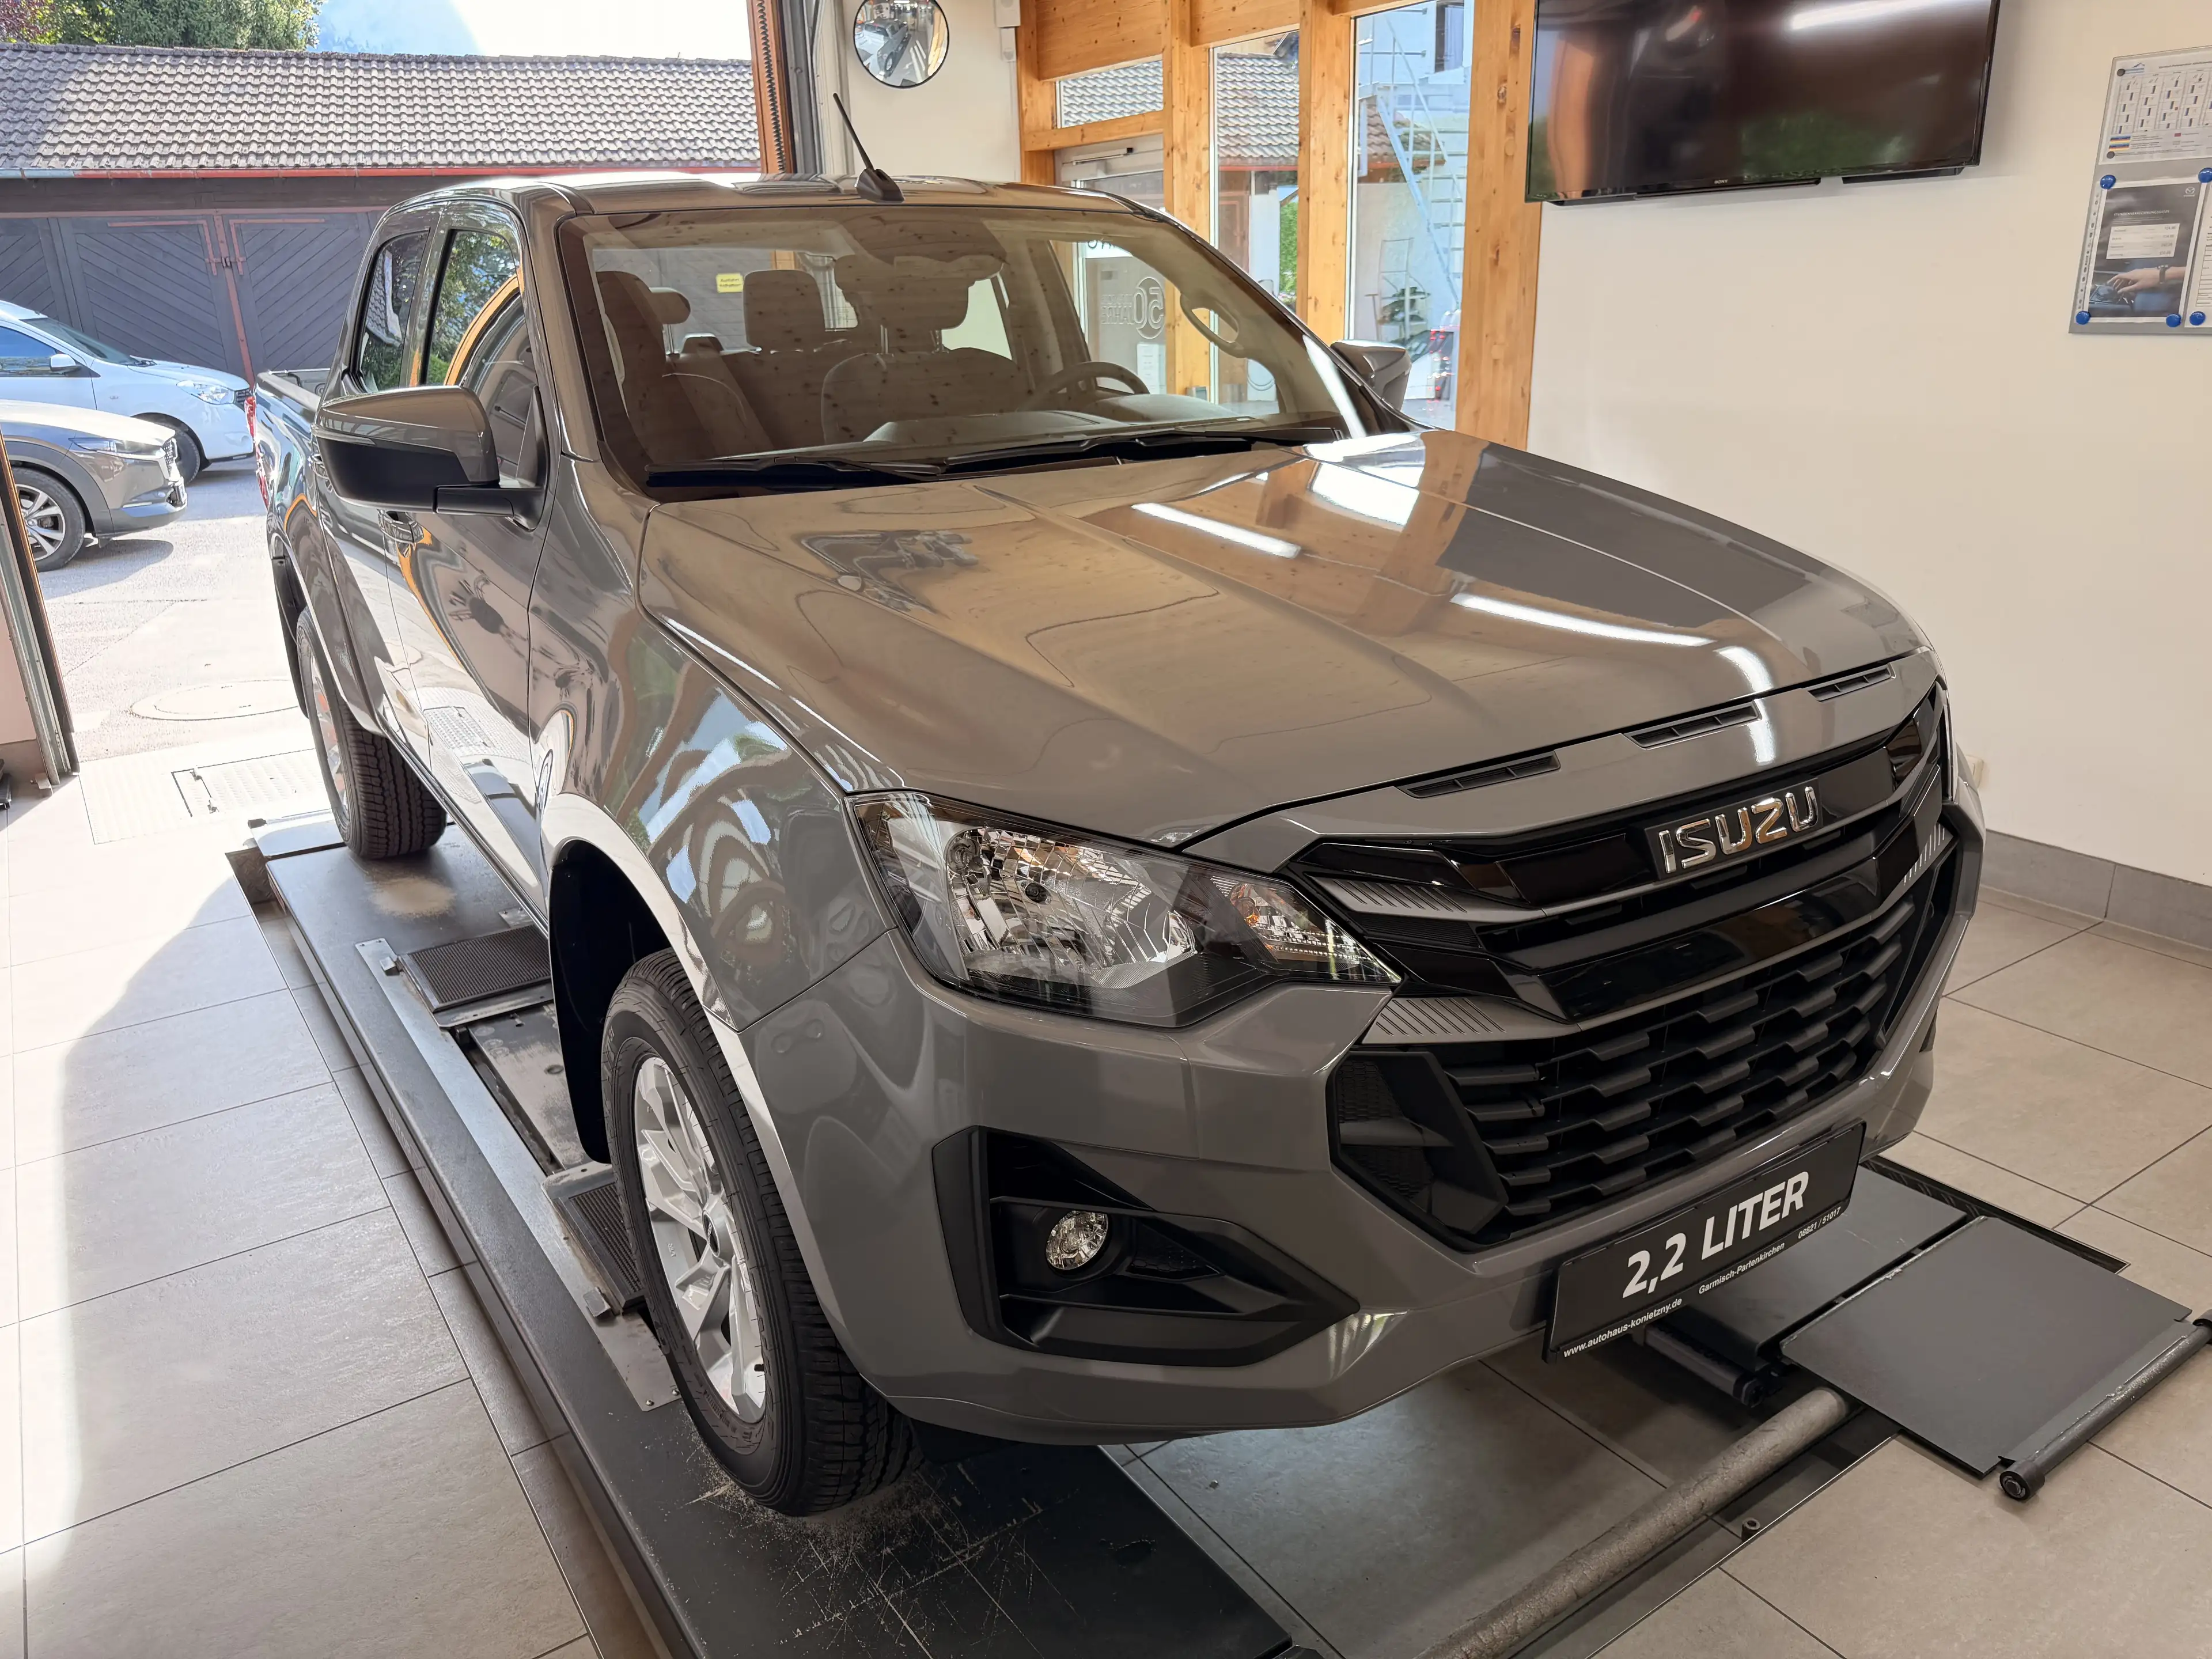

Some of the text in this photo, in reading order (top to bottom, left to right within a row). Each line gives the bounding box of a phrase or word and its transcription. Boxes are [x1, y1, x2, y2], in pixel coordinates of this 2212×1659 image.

[1658, 786, 1819, 873] ISUZU
[1563, 1297, 1683, 1358] www.autohaus-konietzny.de
[1699, 1242, 1785, 1295] Garmisch-Partenkirchen
[1798, 1221, 1818, 1240] 08821
[1822, 1206, 1842, 1225] 51017
[1622, 1171, 1809, 1299] 2,2 LITER
